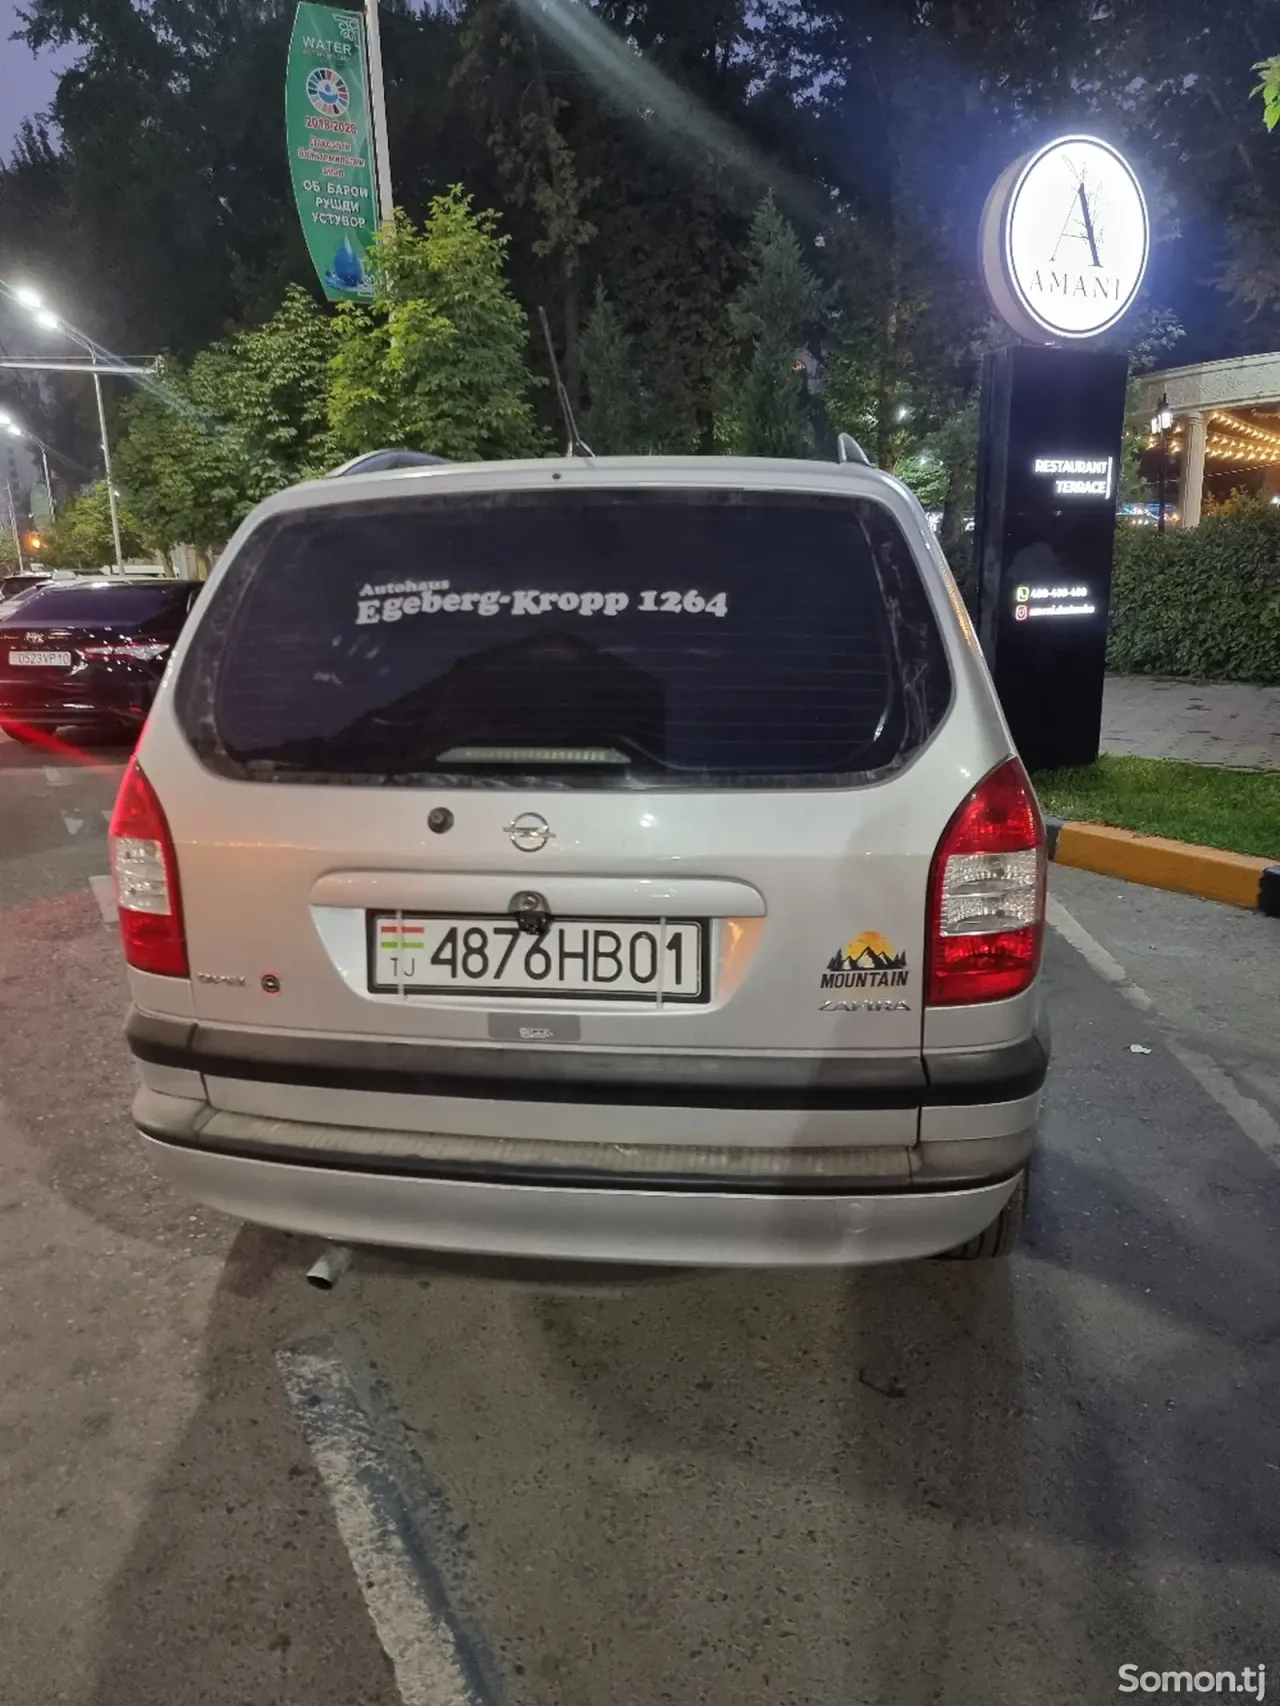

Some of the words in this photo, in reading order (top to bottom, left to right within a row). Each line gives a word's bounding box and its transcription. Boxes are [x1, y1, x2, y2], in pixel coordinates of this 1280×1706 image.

[302, 35, 352, 56] WATER
[305, 115, 358, 134] 2018-2028
[303, 179, 321, 193] ОБ
[315, 196, 360, 213] РУШДИ
[311, 211, 366, 229] УСТУВОР
[1029, 269, 1120, 301] AMANI
[1034, 459, 1108, 475] RESTAURANT
[1055, 480, 1107, 494] TERRACE
[359, 579, 450, 597] Autohaus
[355, 589, 629, 625] Egeberg-Kropp
[638, 589, 729, 618] 1264
[430, 926, 683, 986] 4876HB01
[390, 957, 416, 978] TJ
[820, 970, 910, 989] MOUNTAIN
